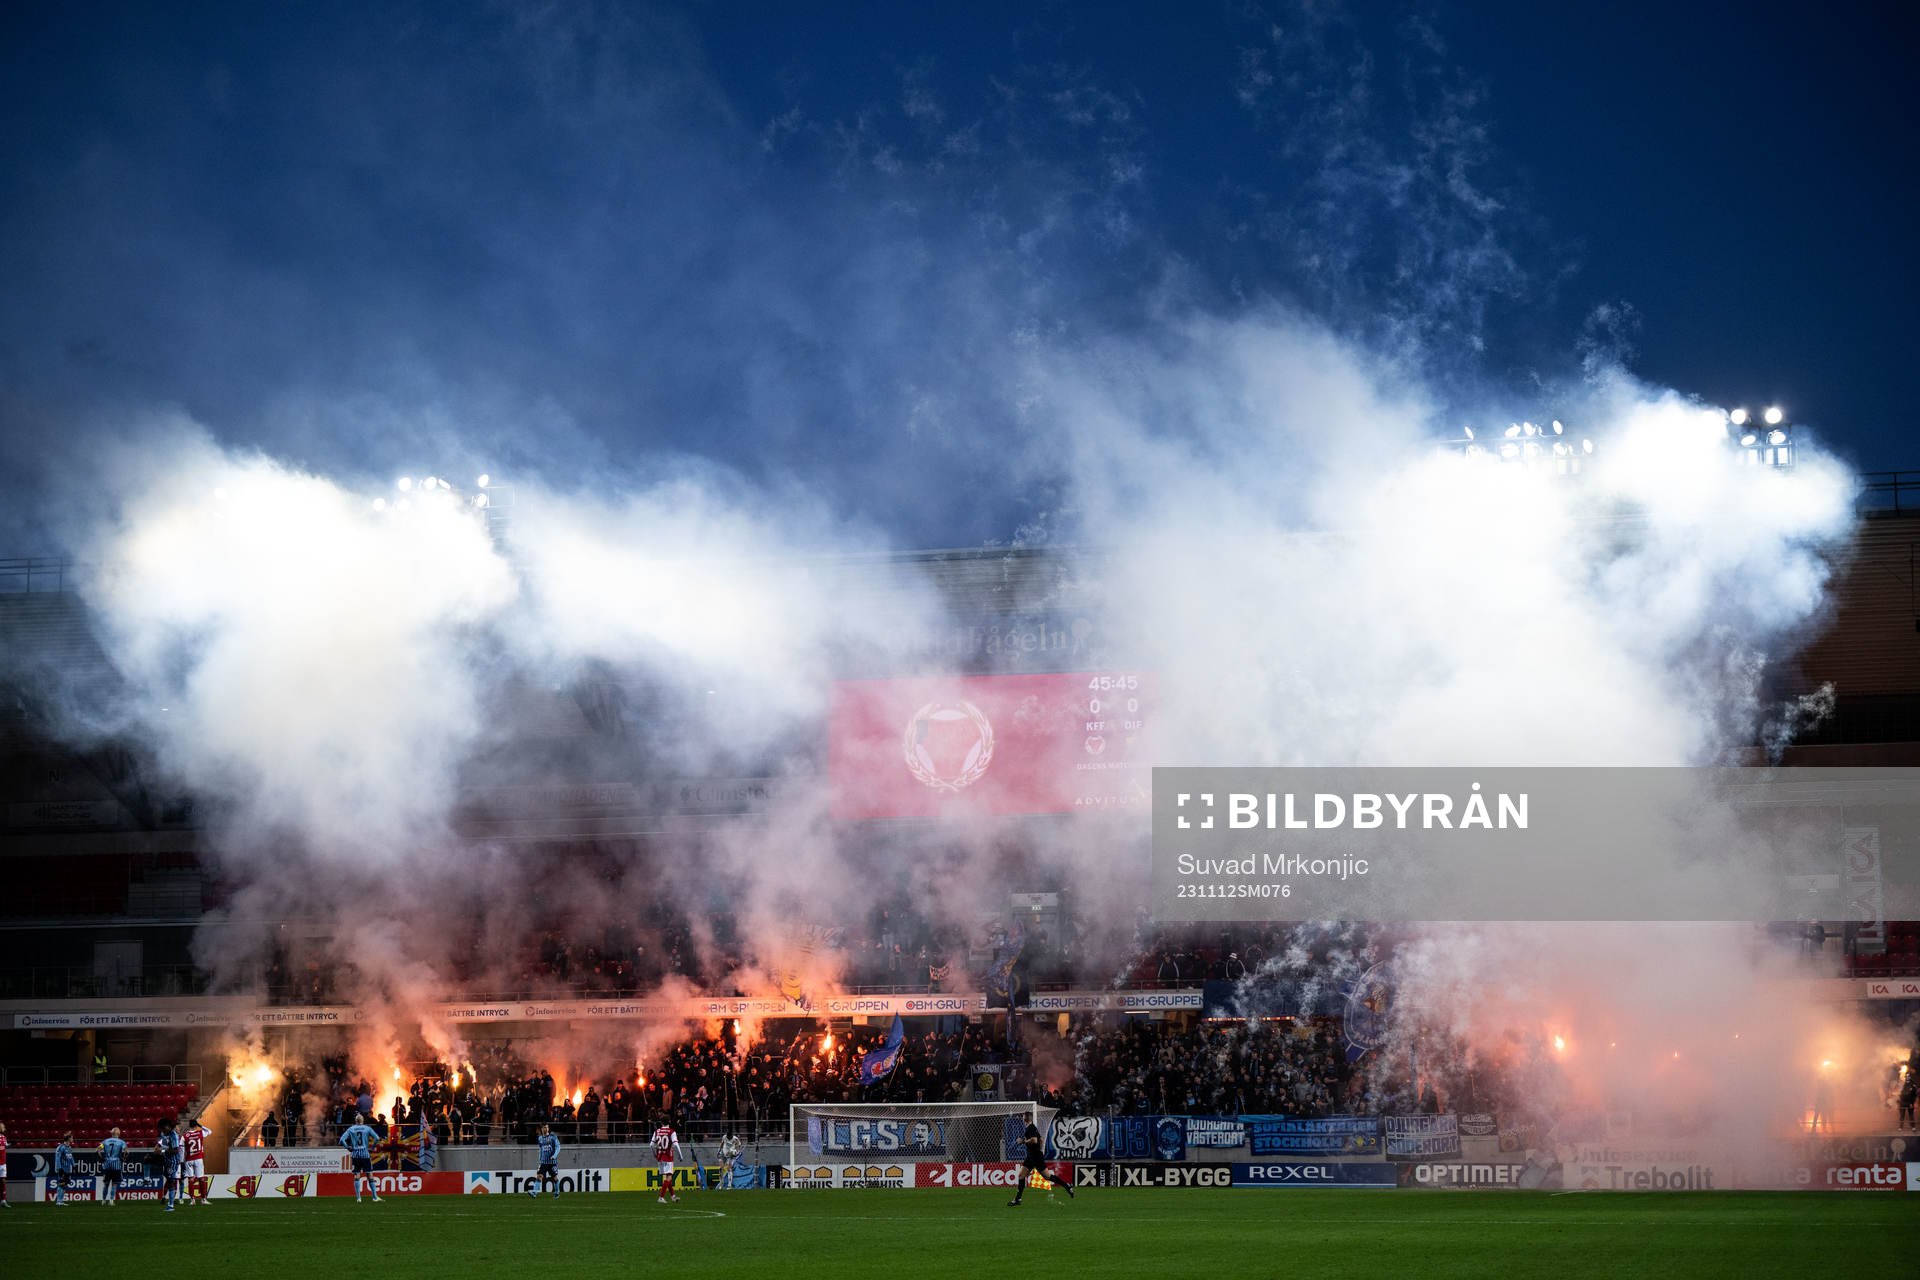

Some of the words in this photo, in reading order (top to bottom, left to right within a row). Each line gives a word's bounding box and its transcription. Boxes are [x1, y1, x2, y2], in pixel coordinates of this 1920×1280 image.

[1087, 675, 1138, 690] 45:45
[1089, 698, 1101, 714] 0
[1127, 697, 1138, 713] 0
[1086, 721, 1105, 731] KFF
[1850, 832, 1875, 882] ICA
[1872, 985, 1889, 994] ICA
[1902, 984, 1920, 993] ICA
[476, 1008, 509, 1016] INTRYCK
[605, 1006, 618, 1014] ETT
[80, 1016, 95, 1025] FÖR
[96, 1016, 110, 1024] ETT
[111, 1015, 138, 1024] BÄTTRE
[276, 1013, 304, 1021] BÄTTRE
[306, 1012, 338, 1020] INTRYCK
[356, 1131, 363, 1146] 3
[656, 1135, 669, 1150] 20
[1186, 1131, 1245, 1145] VÄSTERORT
[1254, 1136, 1342, 1148] STOCKHOLM
[188, 1138, 202, 1153] 21
[1123, 1167, 1231, 1186] XL-BYGG
[1604, 1165, 1714, 1190] Trebolit
[1826, 1163, 1902, 1185] renta
[49, 1179, 92, 1189] SORT
[48, 1192, 91, 1201] VSION
[118, 1191, 159, 1201] VISION
